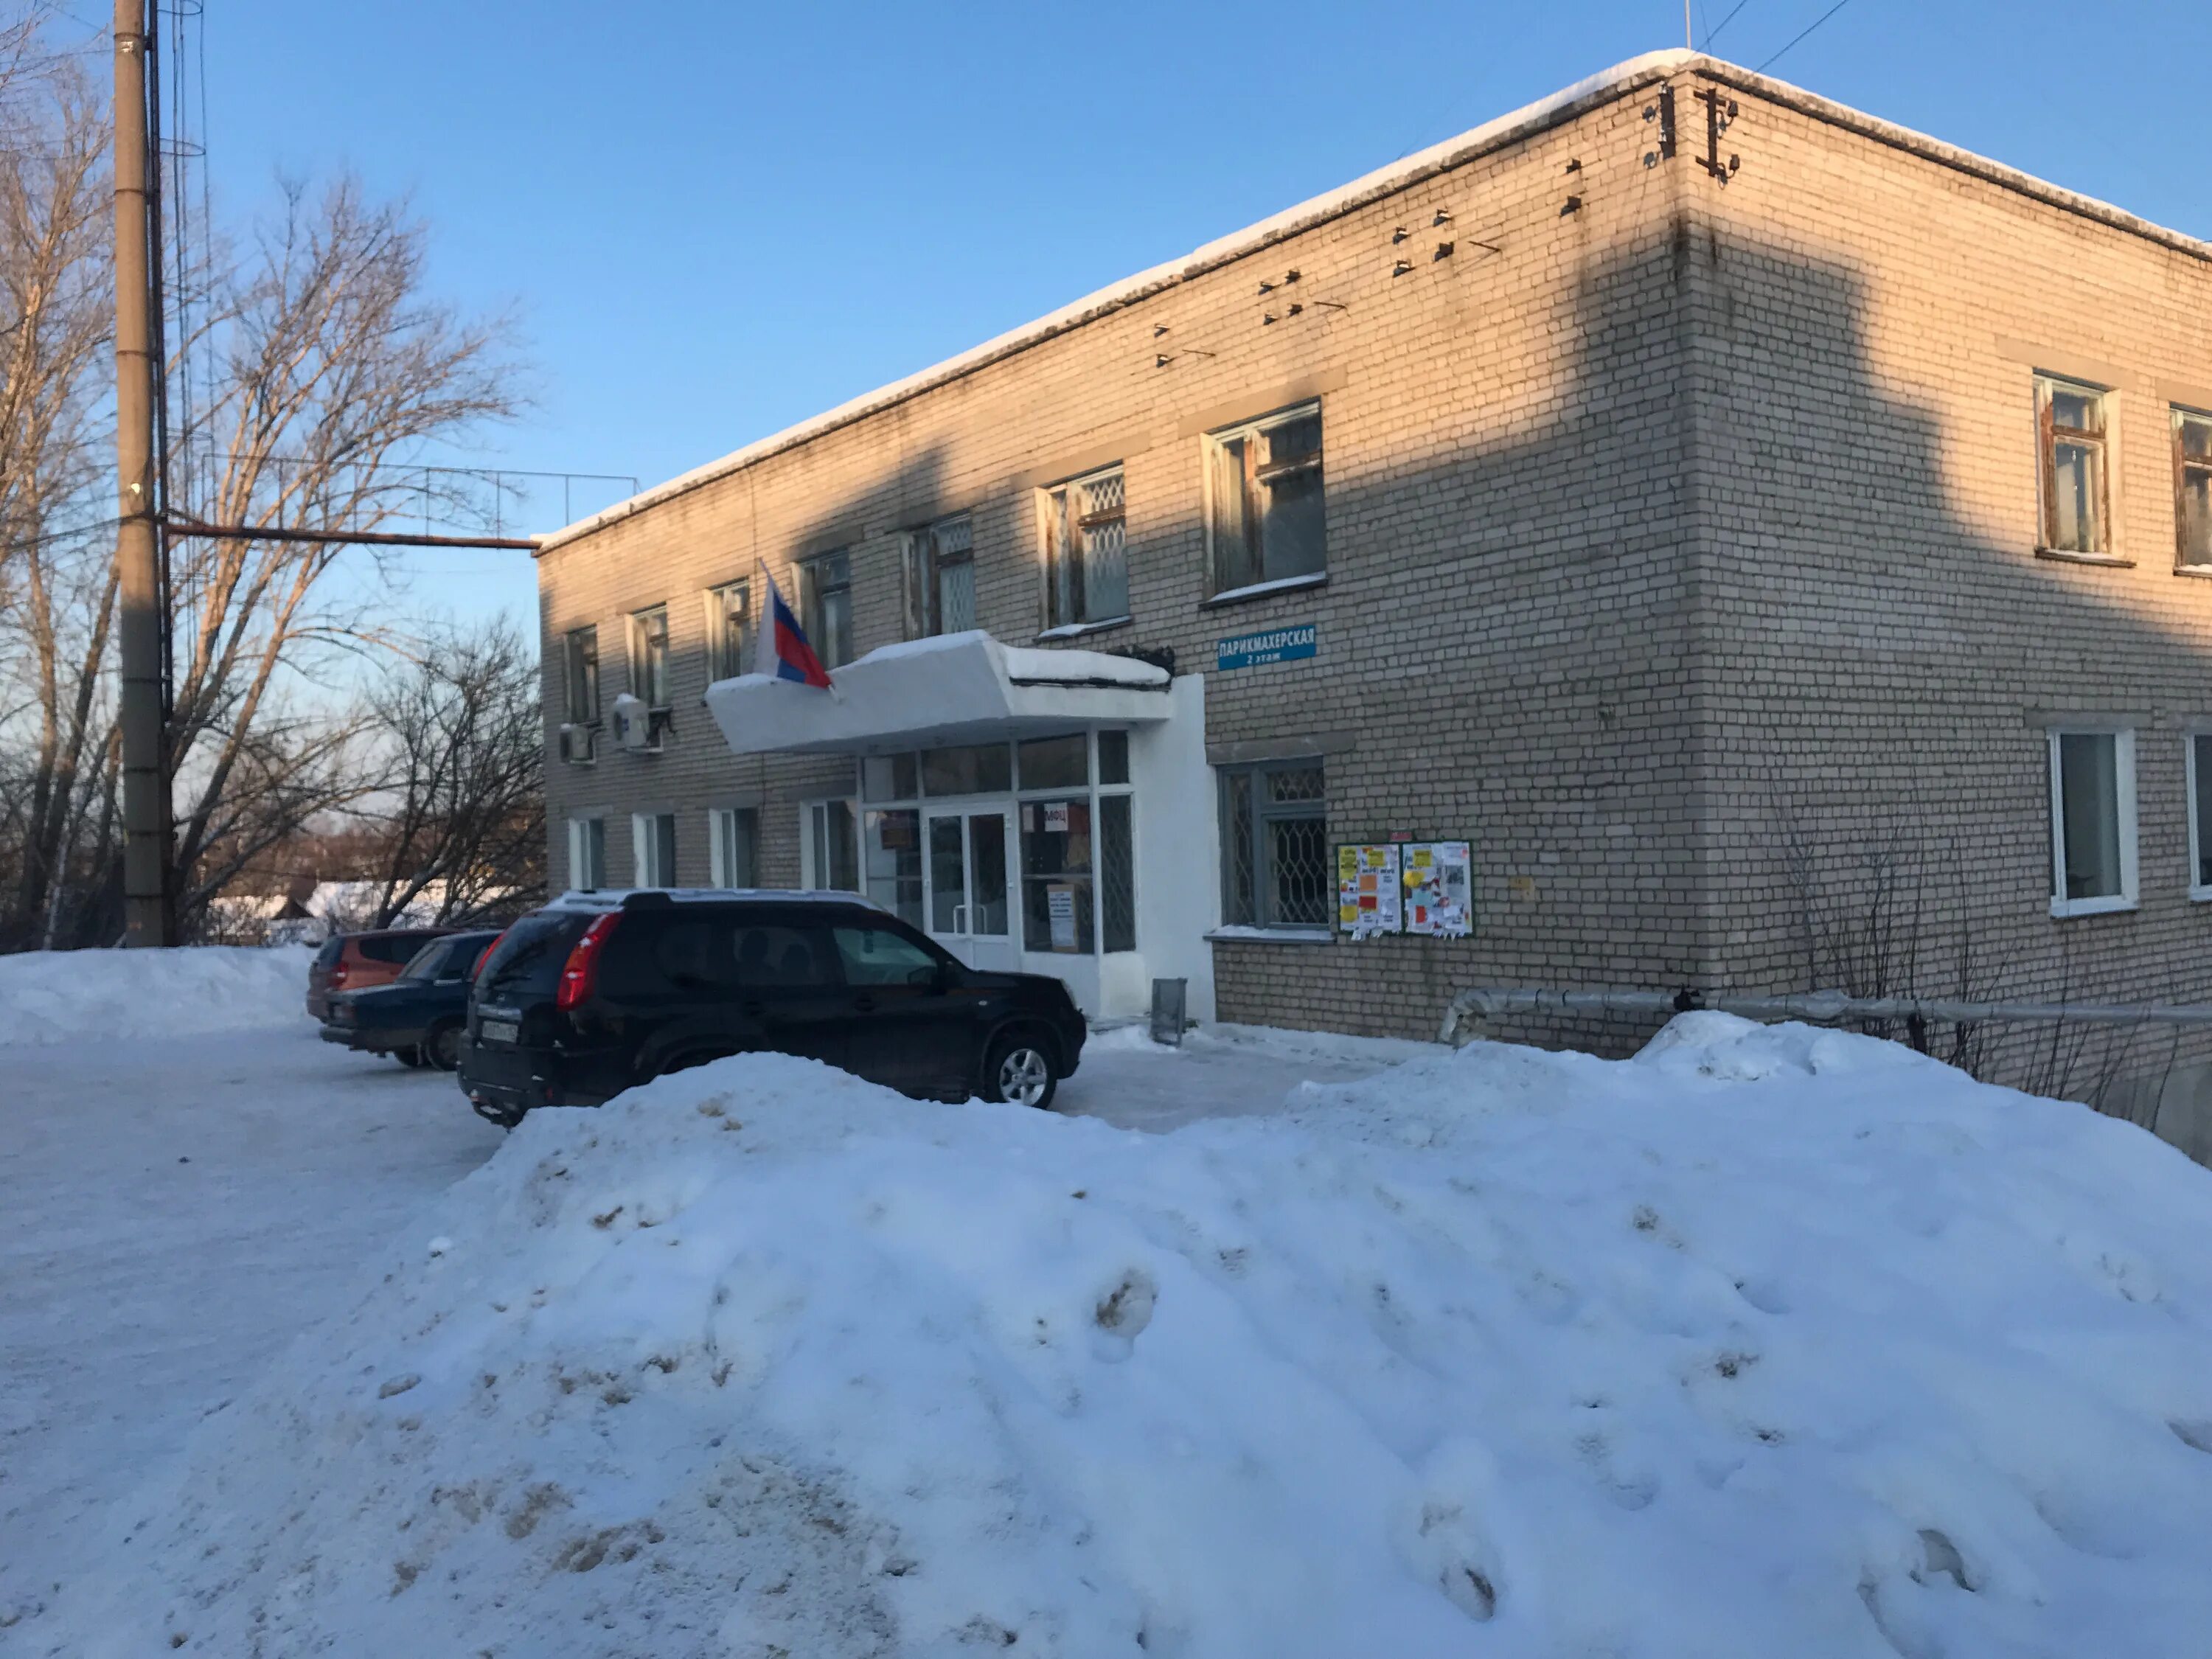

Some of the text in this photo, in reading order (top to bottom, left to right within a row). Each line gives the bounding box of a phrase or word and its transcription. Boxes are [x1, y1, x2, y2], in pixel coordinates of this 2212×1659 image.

[1219, 628, 1314, 657] ПАРИКМАХЕРСКАЯ
[1247, 653, 1281, 664] 2 этаж
[1044, 810, 1066, 822] МФЦ
